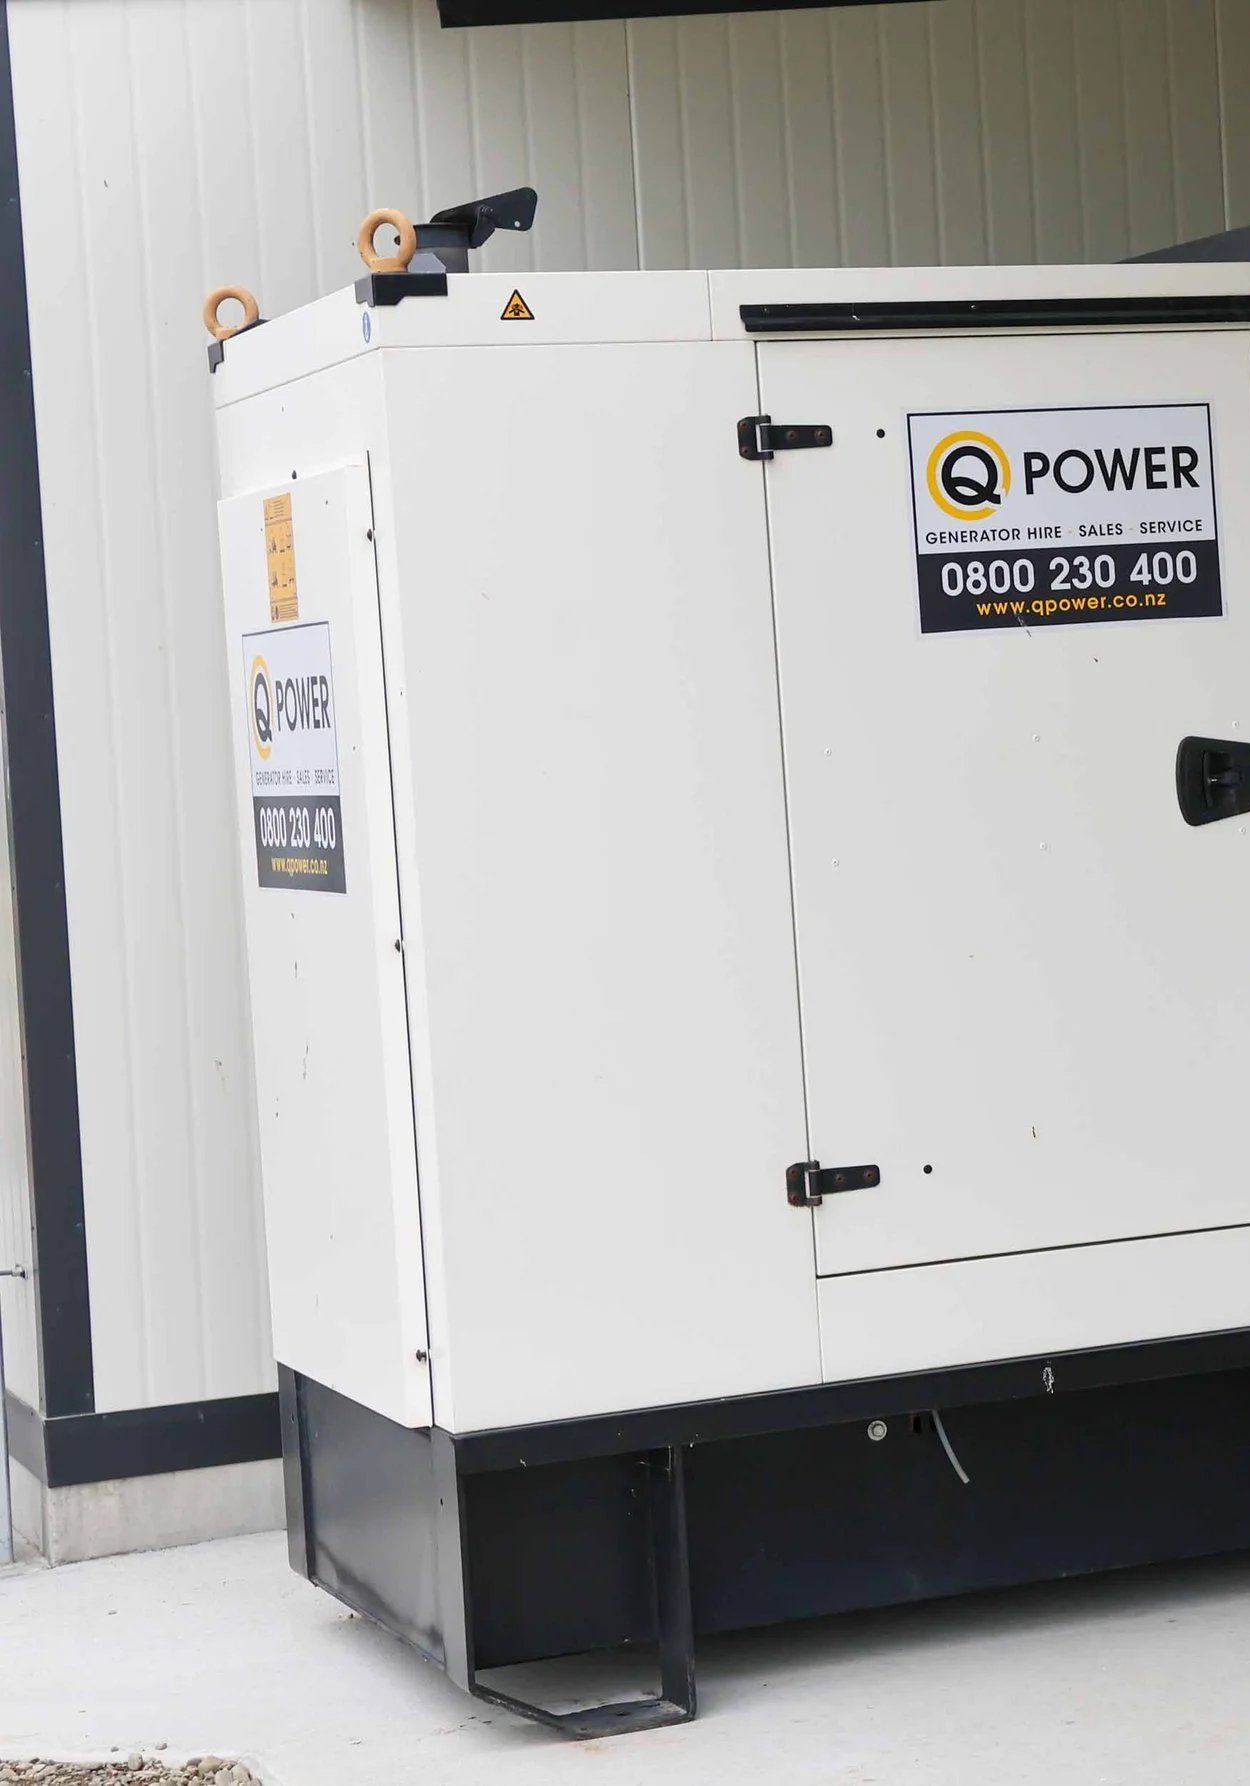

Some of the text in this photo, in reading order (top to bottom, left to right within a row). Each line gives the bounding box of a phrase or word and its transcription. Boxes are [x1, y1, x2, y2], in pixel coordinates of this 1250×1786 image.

[941, 445, 1201, 506] Q POWER
[925, 519, 1203, 545] GENERATOR HIRE SALES SERVICE
[941, 550, 1198, 597] 0800 230 400
[976, 592, 1167, 616] www.qpower.co.nz
[254, 672, 331, 742] Q POWER
[255, 770, 281, 785] GENERATOR
[296, 769, 310, 785] SALES
[314, 768, 335, 785] SERVICE
[260, 806, 336, 850] 0800 230 400
